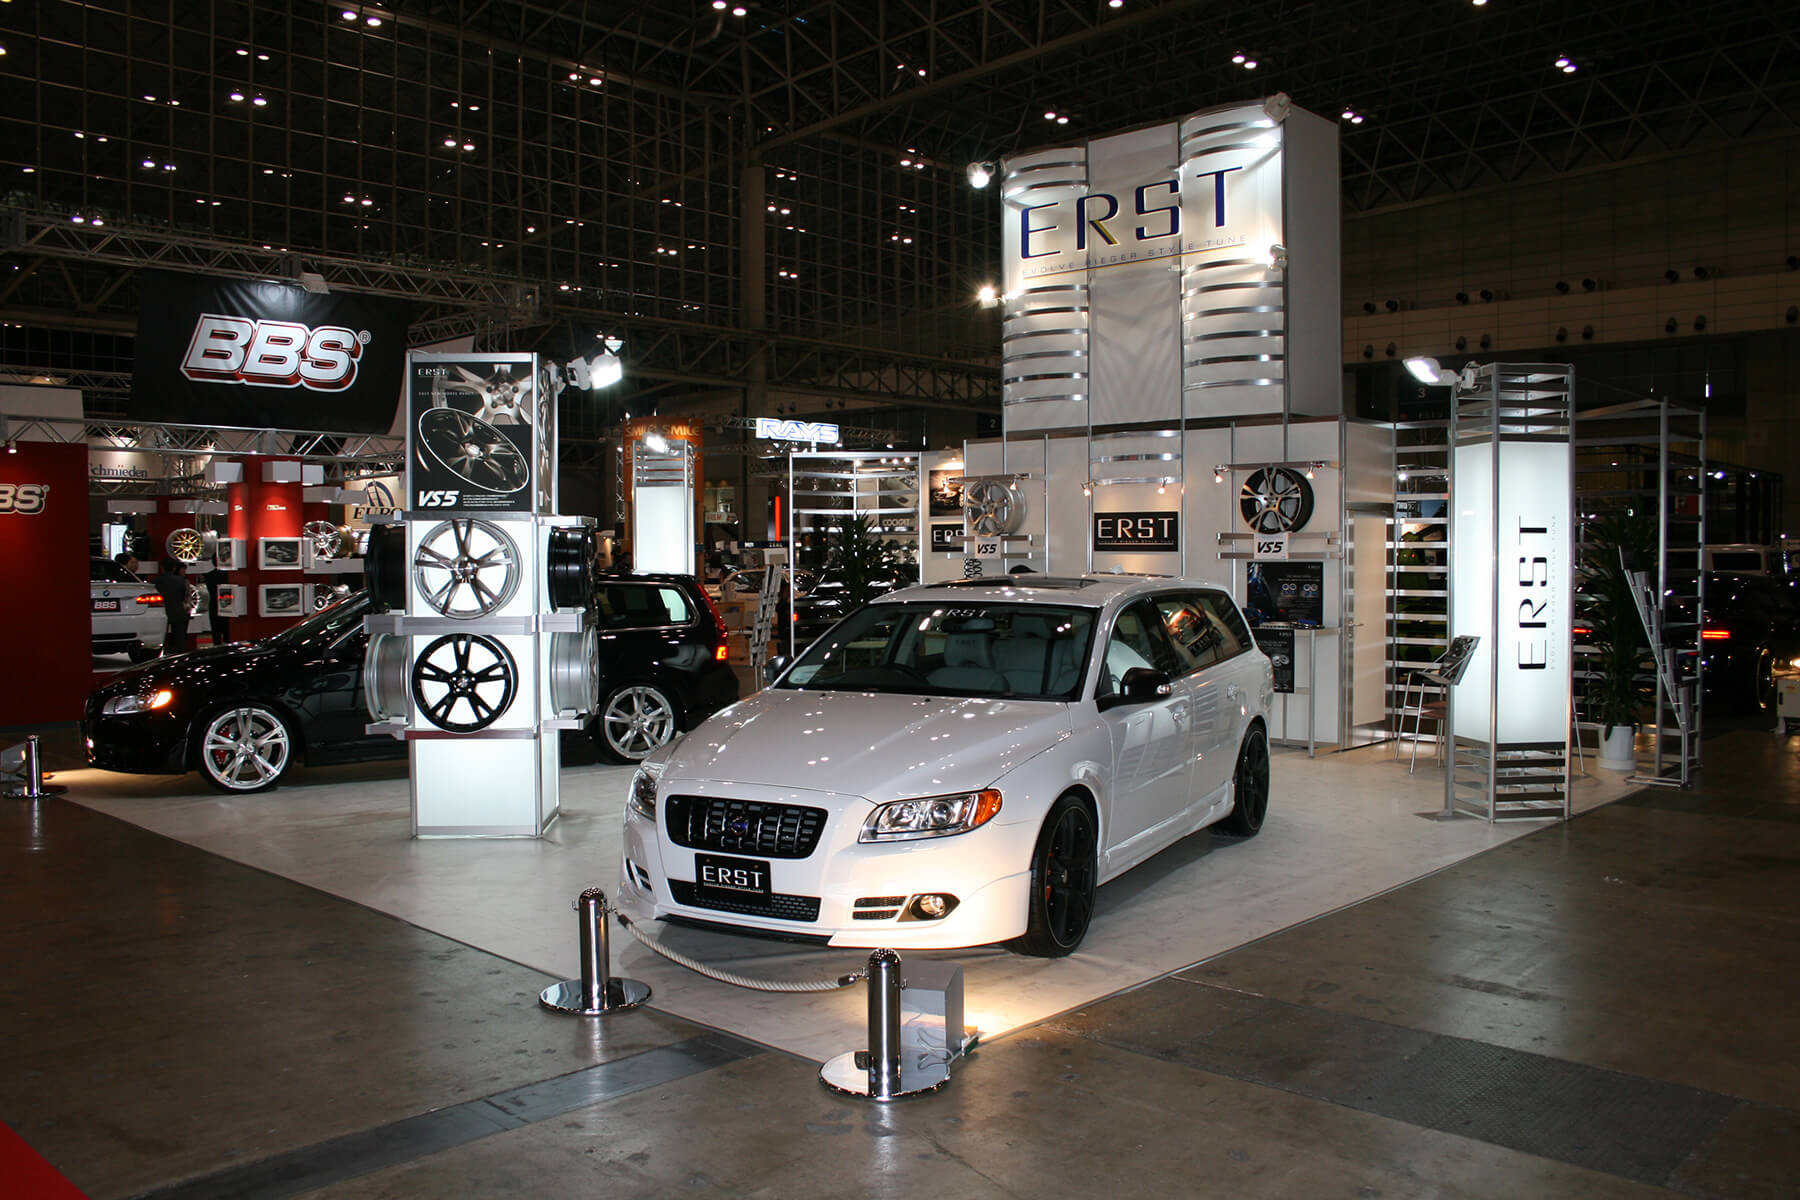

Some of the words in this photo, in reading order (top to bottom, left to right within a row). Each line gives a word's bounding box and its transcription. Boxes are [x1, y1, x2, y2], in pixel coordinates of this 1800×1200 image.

[1020, 166, 1244, 260] ERST
[1207, 234, 1246, 247] TUNE
[757, 418, 839, 443] RAYS
[418, 490, 460, 507] VS5
[1098, 518, 1175, 538] ERST
[977, 544, 998, 554] VS5
[1257, 542, 1284, 553] VS5
[1518, 514, 1548, 670] ERST
[94, 600, 118, 609] BBS
[933, 608, 991, 617] RST
[702, 865, 764, 888] ERST
